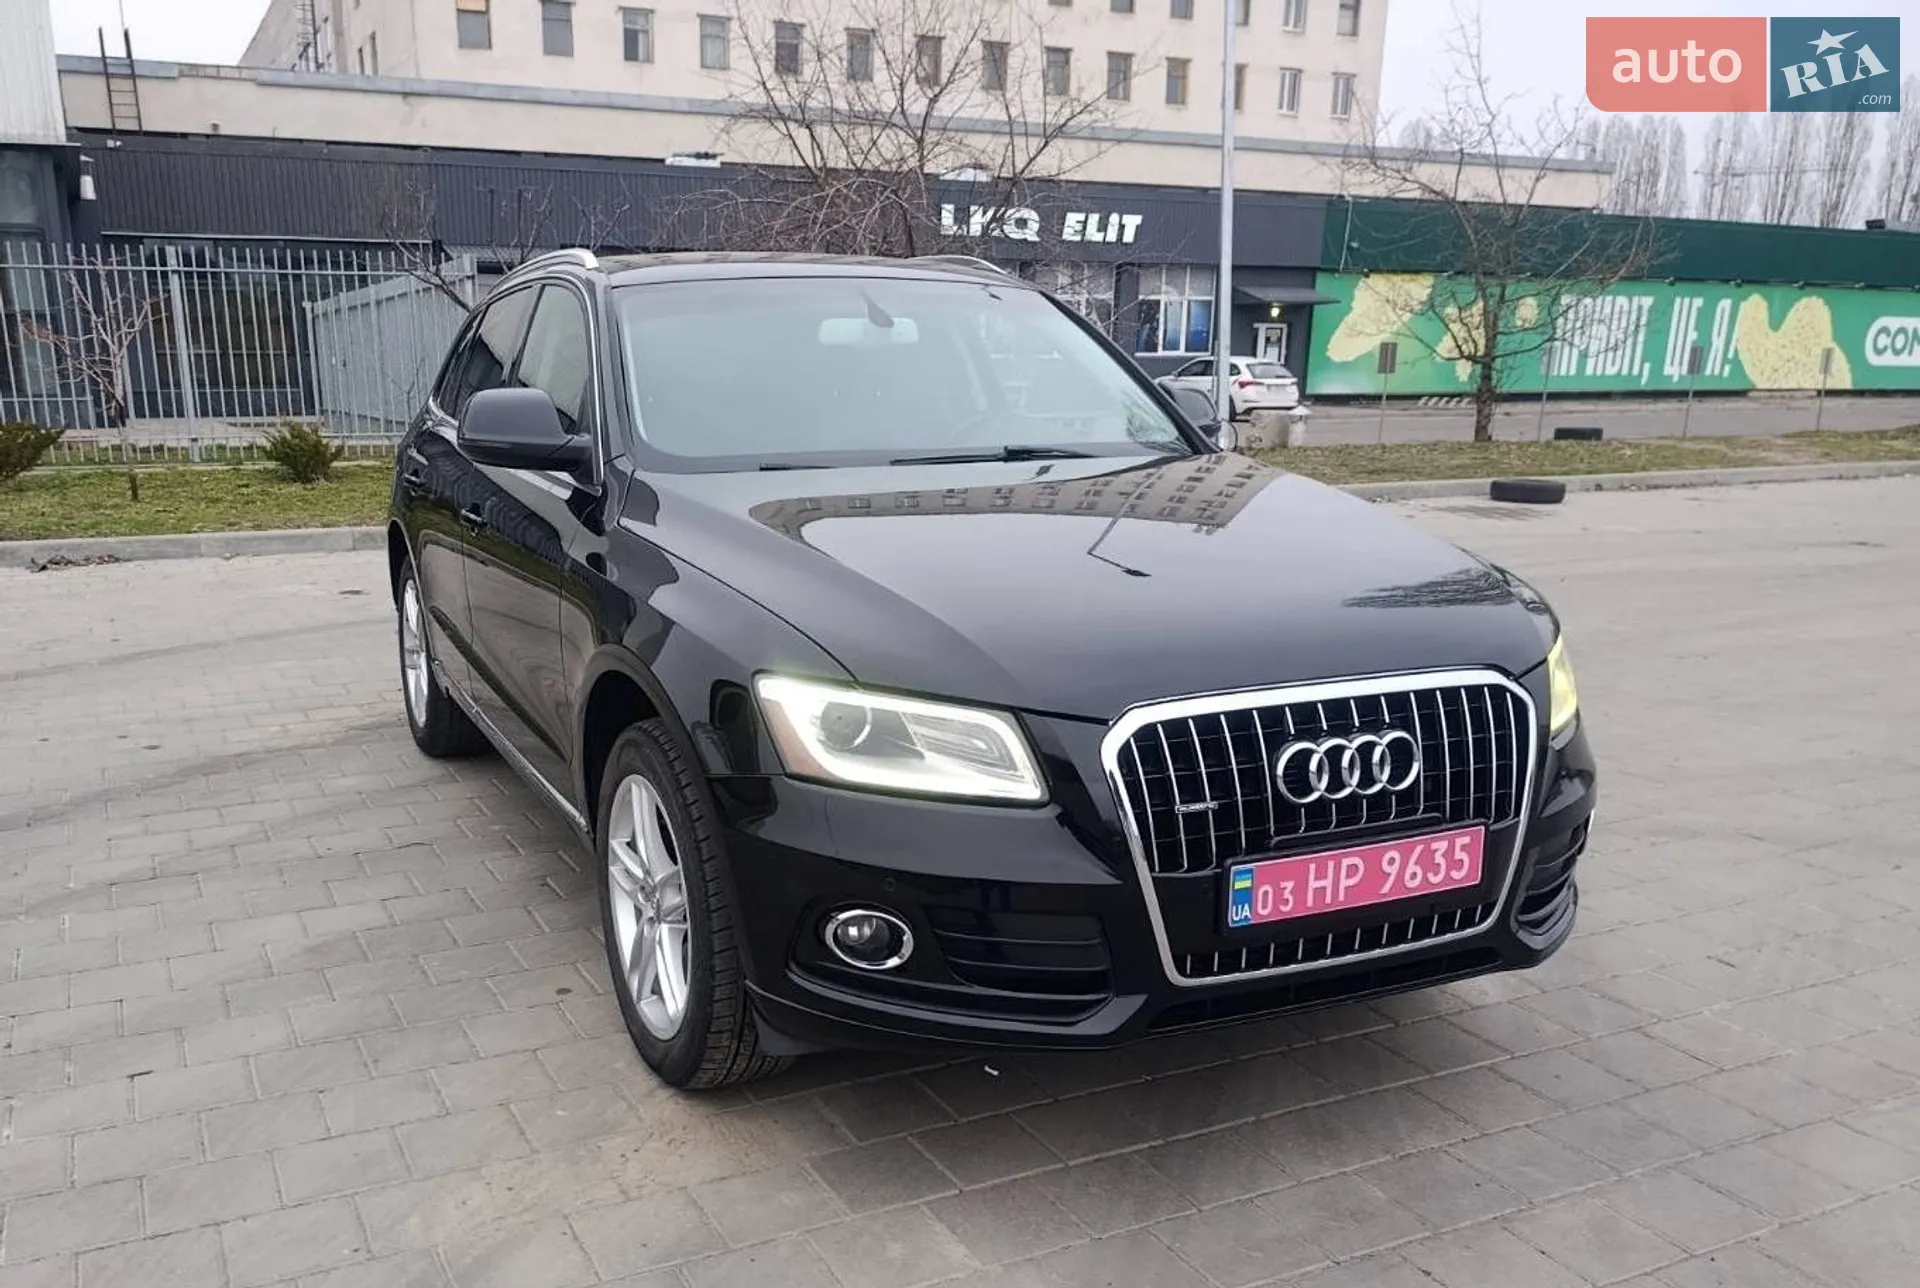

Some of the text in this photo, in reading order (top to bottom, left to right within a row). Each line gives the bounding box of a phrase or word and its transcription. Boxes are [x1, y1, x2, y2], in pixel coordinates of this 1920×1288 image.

[1256, 835, 1472, 916] 03 HP 9635
[1231, 903, 1253, 921] UA
